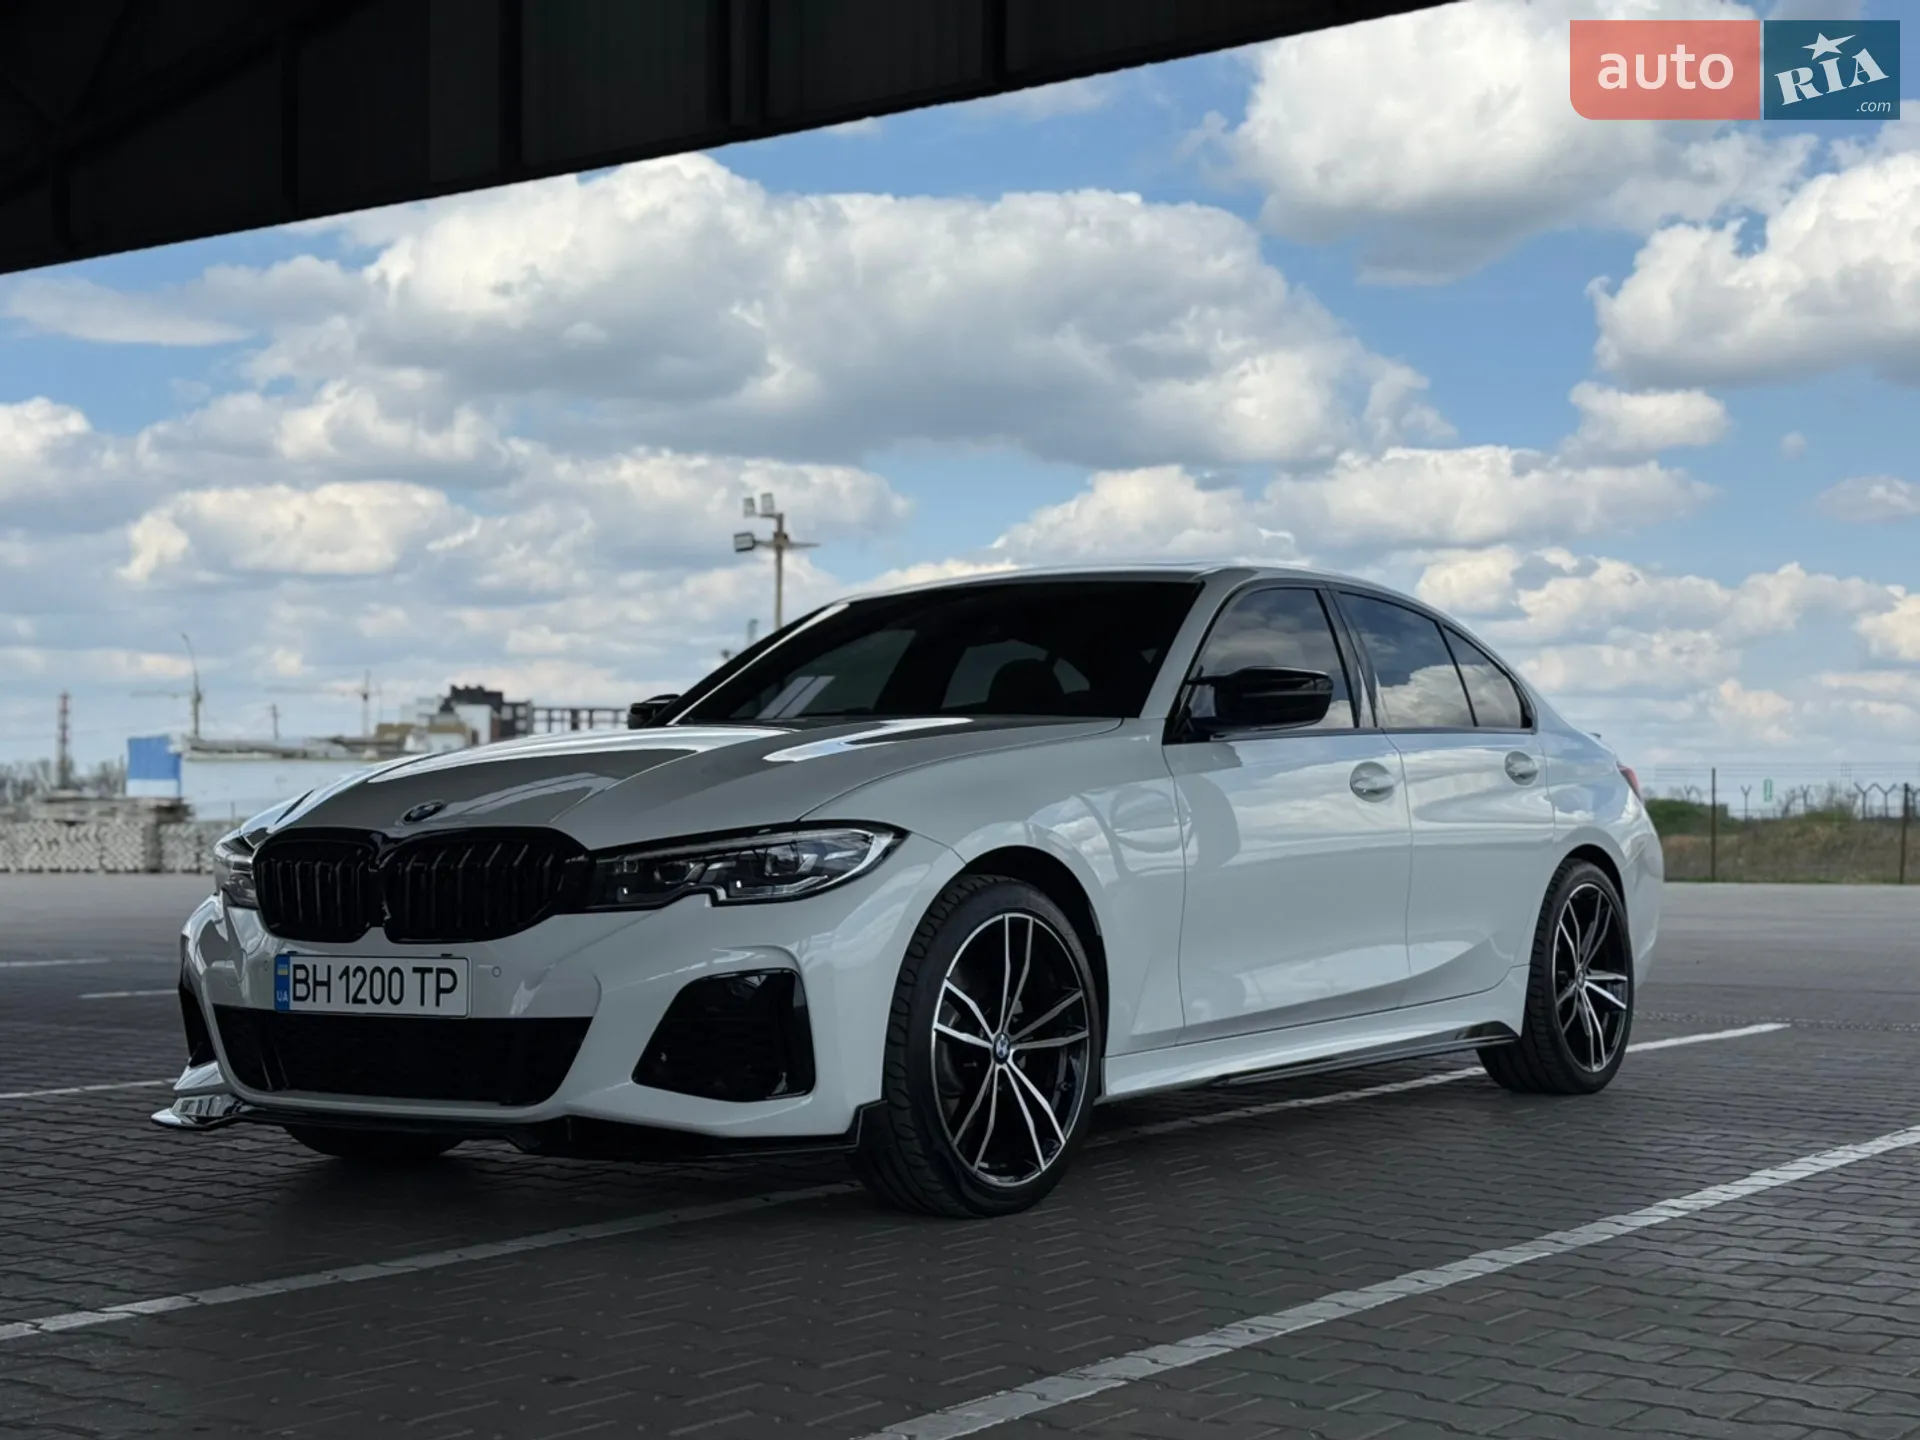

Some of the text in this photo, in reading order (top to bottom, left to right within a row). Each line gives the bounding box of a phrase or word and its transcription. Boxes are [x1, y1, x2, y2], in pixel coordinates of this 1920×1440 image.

[276, 990, 289, 1002] UA
[292, 963, 458, 1007] BH 1200 TP
